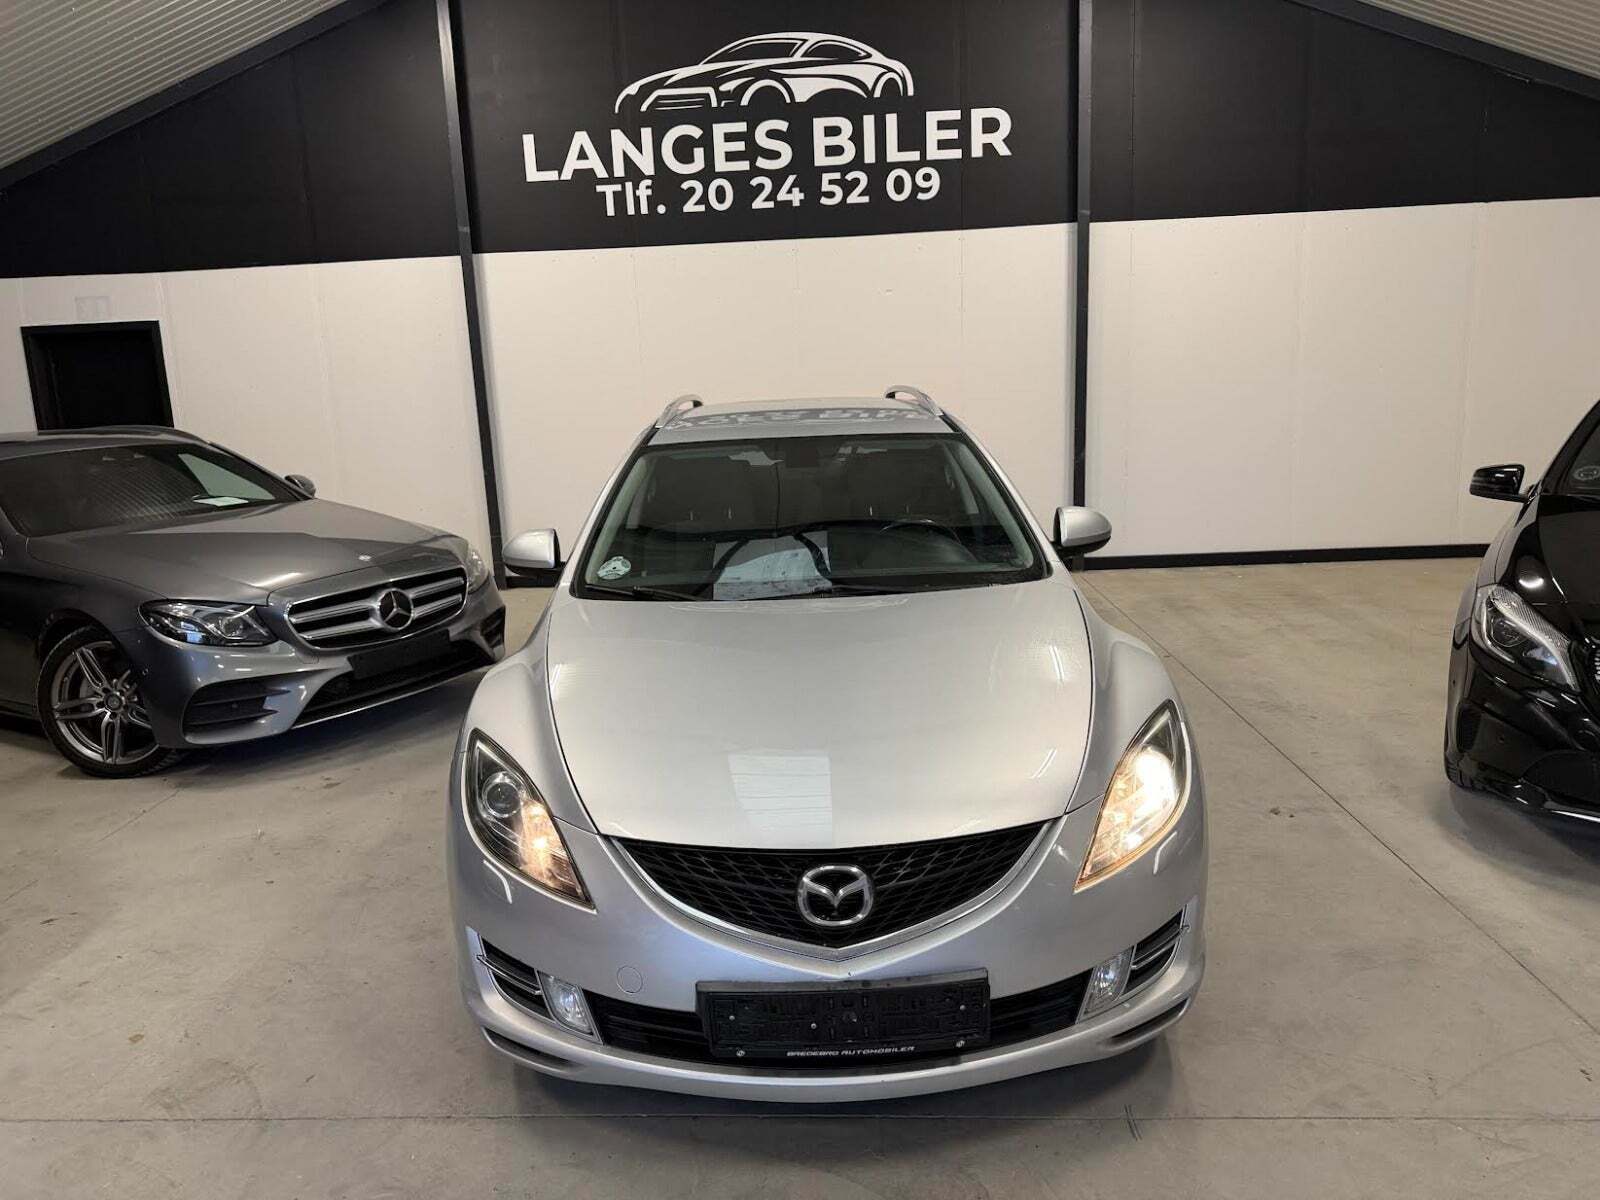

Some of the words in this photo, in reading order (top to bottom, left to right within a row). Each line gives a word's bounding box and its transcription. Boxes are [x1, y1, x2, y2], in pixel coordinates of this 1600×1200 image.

[522, 119, 793, 183] LANGES
[812, 107, 1012, 167] BILER
[595, 179, 667, 217] Tlf.
[681, 178, 734, 213] 20
[750, 174, 805, 210] 24
[819, 170, 870, 206] 52
[885, 166, 941, 202] 09
[840, 1045, 916, 1056] AUTOMOBILER
